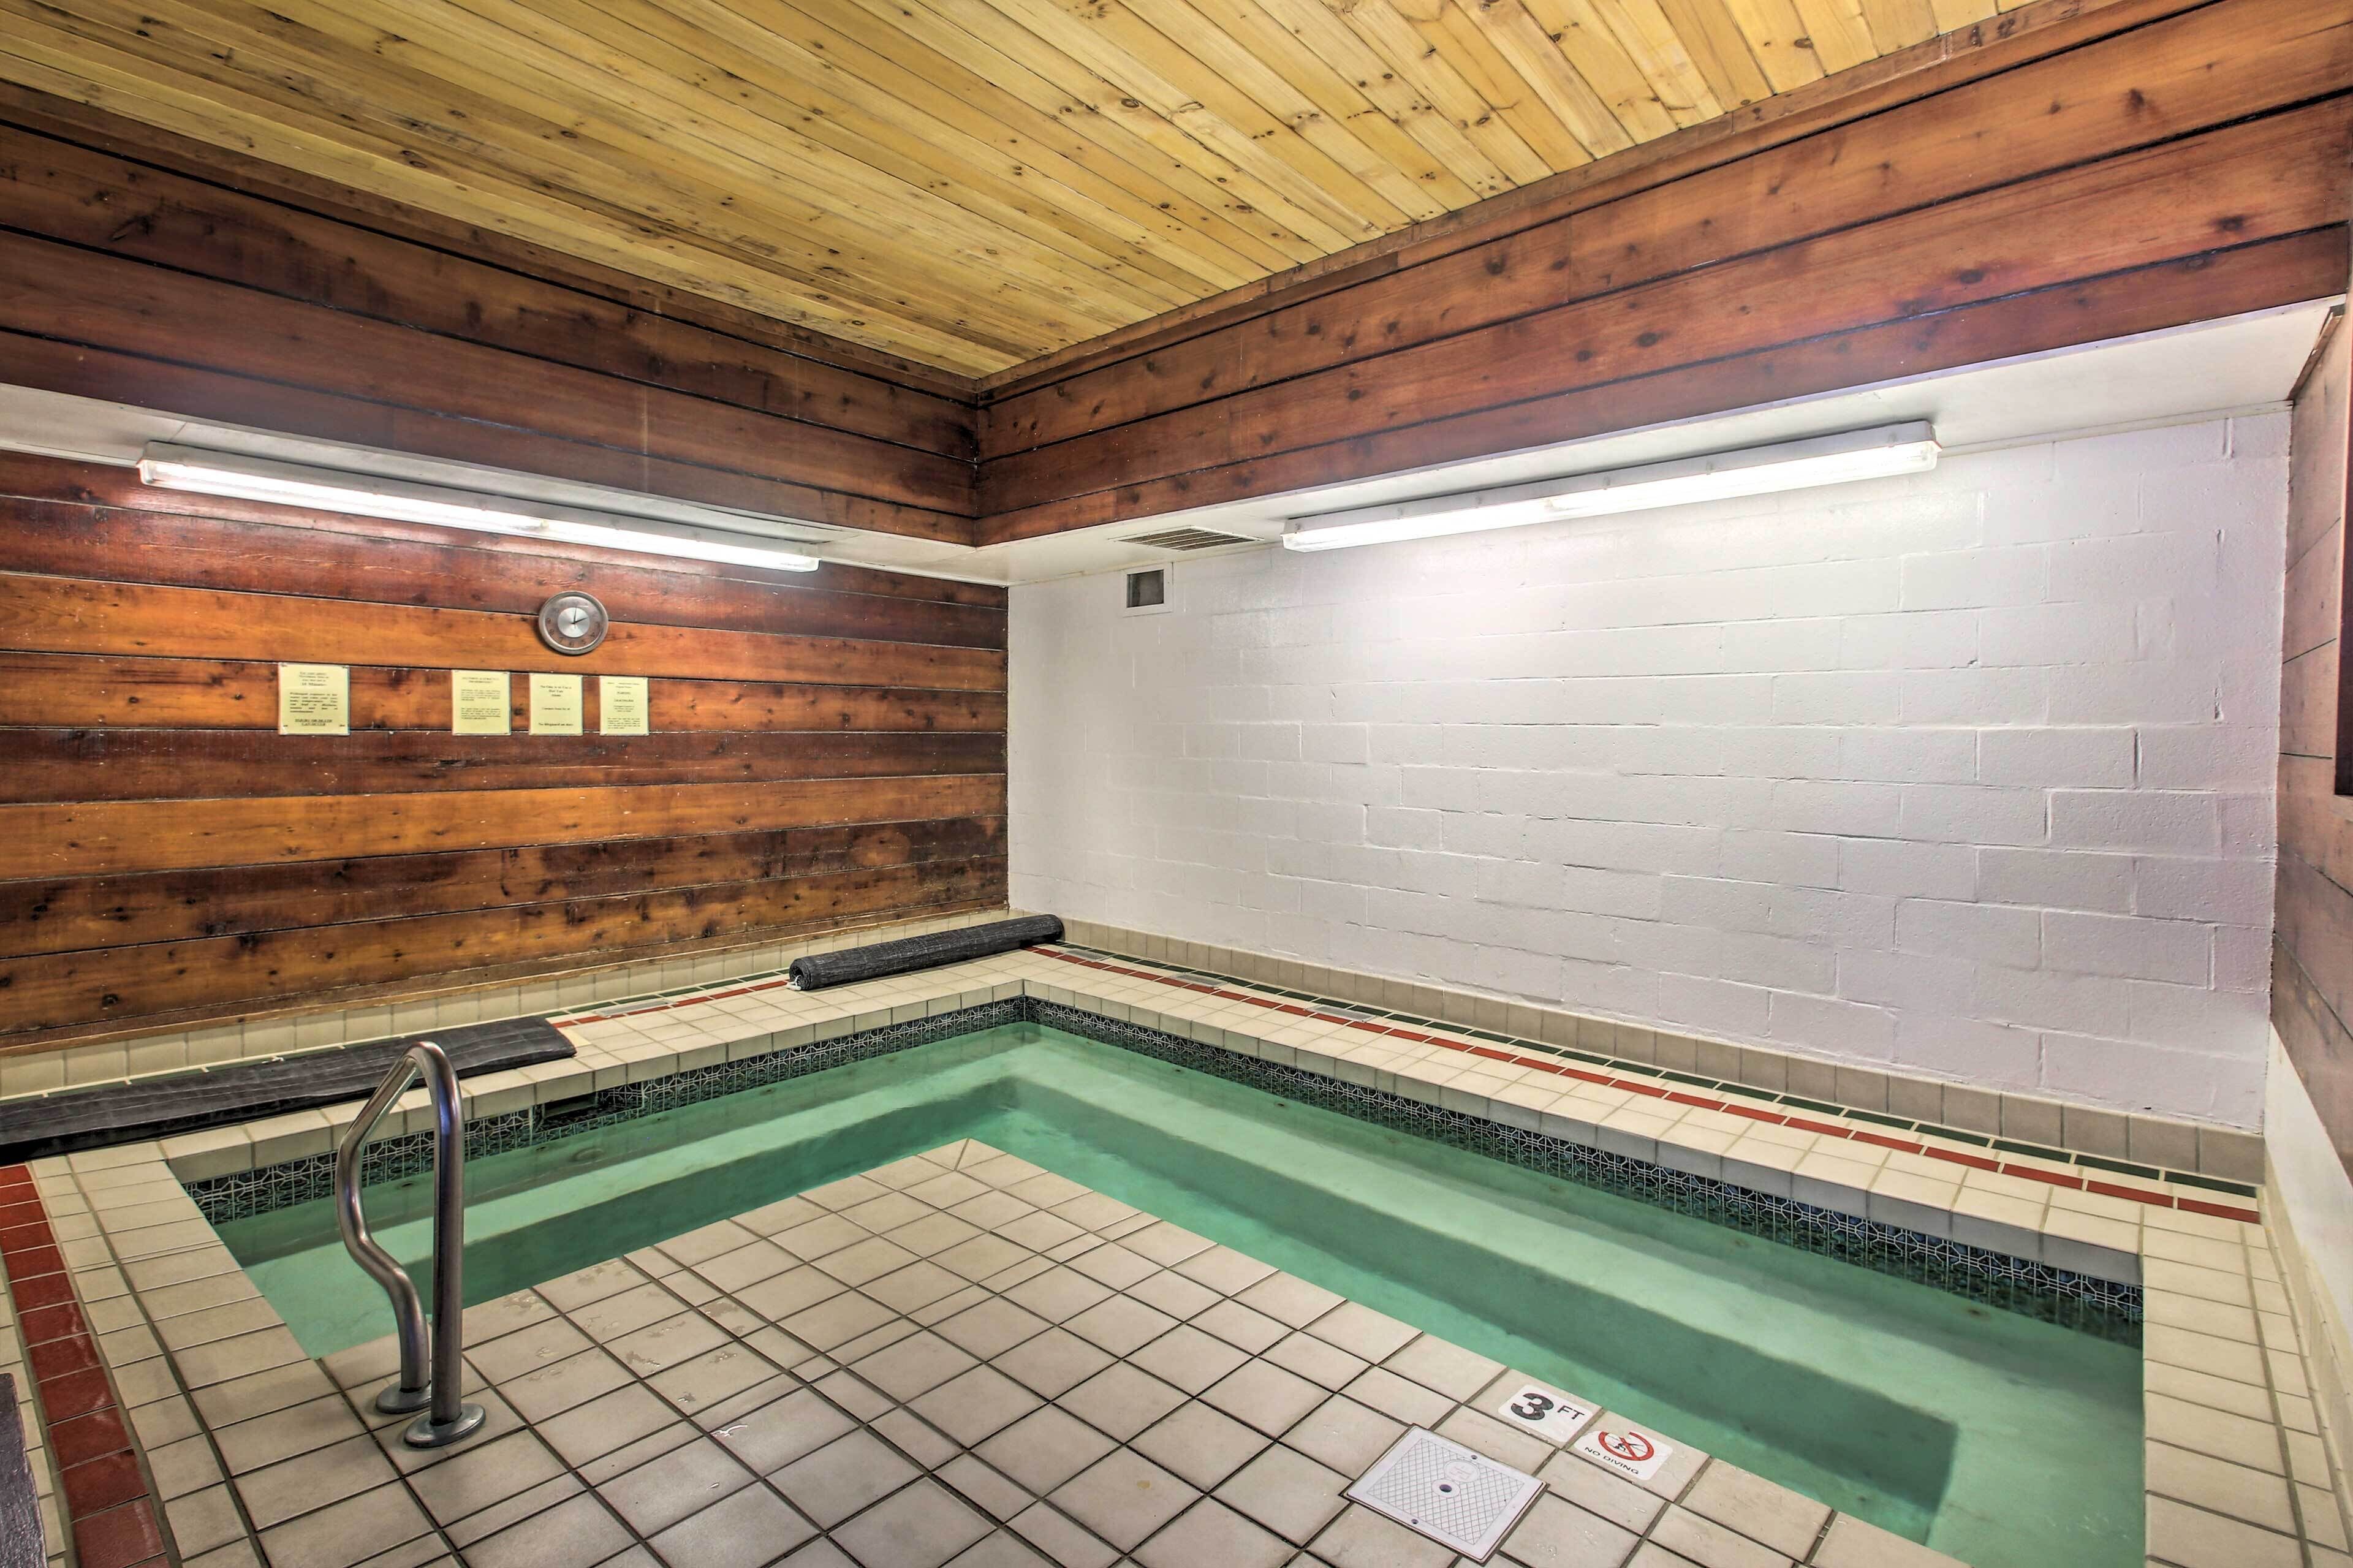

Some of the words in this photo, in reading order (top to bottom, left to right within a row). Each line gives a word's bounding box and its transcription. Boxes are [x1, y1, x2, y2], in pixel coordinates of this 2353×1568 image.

[1510, 1393, 1554, 1420] 3
[1557, 1405, 1585, 1420] FT
[1584, 1447, 1601, 1456] NO
[1603, 1455, 1639, 1474] DIVING
